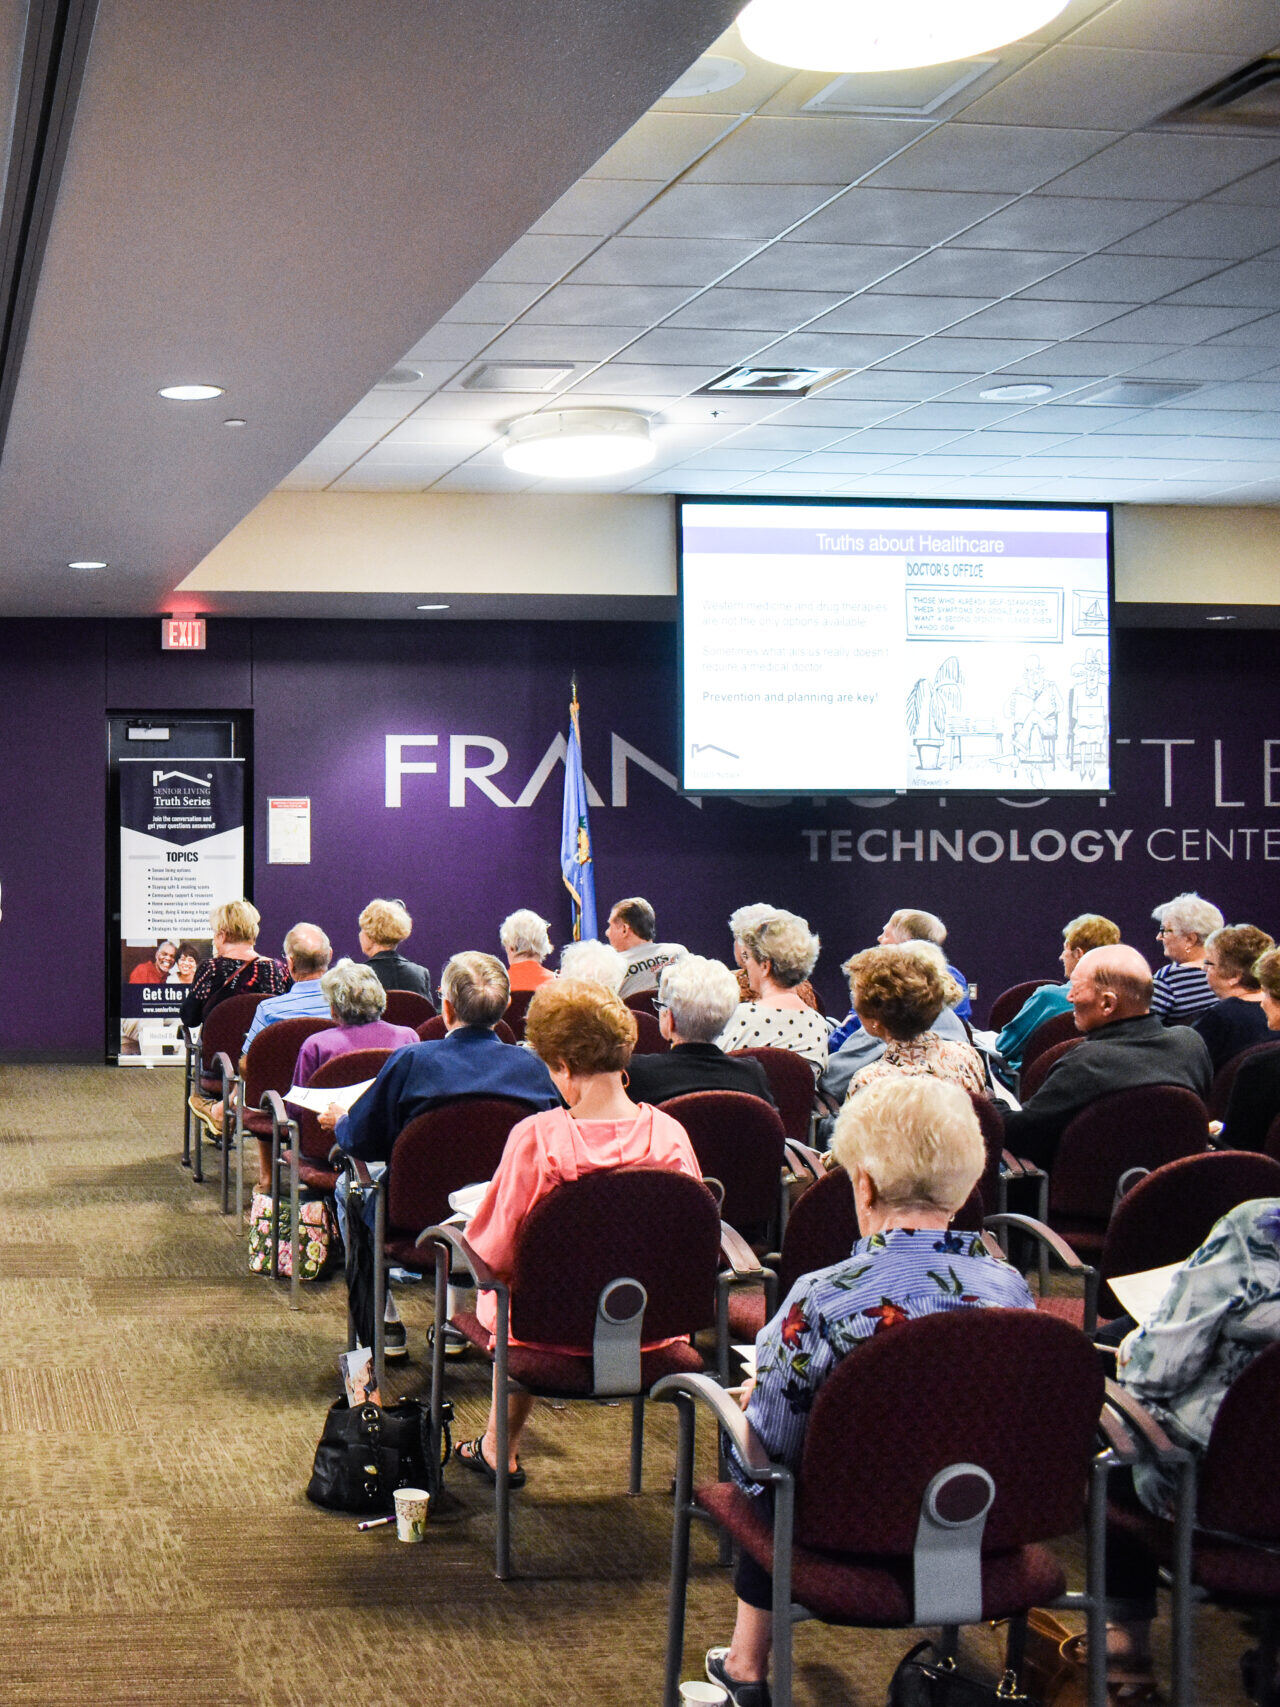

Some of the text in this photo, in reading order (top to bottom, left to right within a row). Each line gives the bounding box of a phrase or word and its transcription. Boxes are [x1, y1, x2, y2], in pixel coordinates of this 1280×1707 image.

[816, 533, 1004, 554] Truths about Healthcare
[906, 563, 984, 578] DOCTOR'S OFFICE
[169, 622, 201, 646] EXIT
[703, 692, 878, 704] Prevention and planning are key!
[385, 732, 792, 809] FRAN
[154, 796, 211, 806] Truth Series
[801, 828, 1133, 862] TECHNOLOGY
[166, 852, 198, 862] TOPICS
[143, 988, 162, 1000] Get
[165, 988, 182, 1000] the
